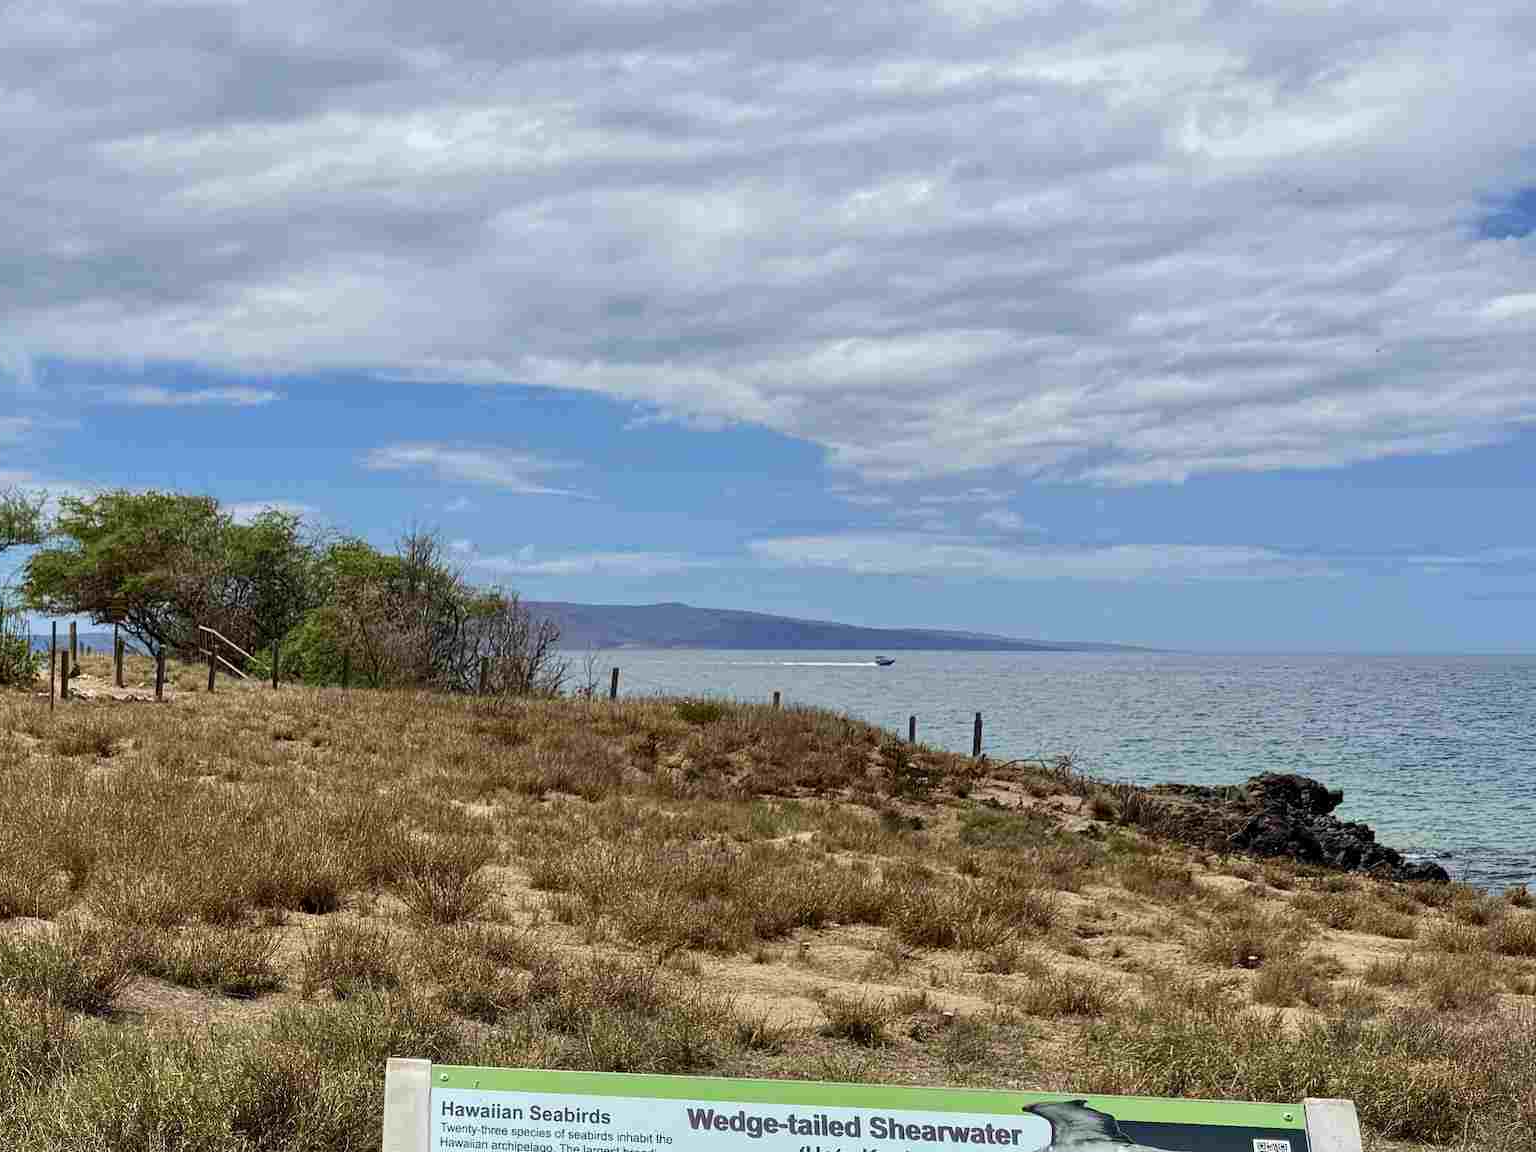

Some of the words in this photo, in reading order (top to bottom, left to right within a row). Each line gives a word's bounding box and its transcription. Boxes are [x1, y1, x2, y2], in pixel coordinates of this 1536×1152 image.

[441, 1101, 522, 1119] Hawaiian
[529, 1105, 610, 1124] Seabirds
[440, 1123, 508, 1138] Twenty-three
[511, 1126, 551, 1140] species
[554, 1128, 564, 1139] of
[567, 1129, 613, 1141] seabirds
[616, 1132, 652, 1143] inhabit
[655, 1134, 672, 1144] the
[687, 1108, 862, 1143] Wedge-tailed
[869, 1117, 1024, 1146] Shearwater
[439, 1137, 488, 1150] Hawaiian
